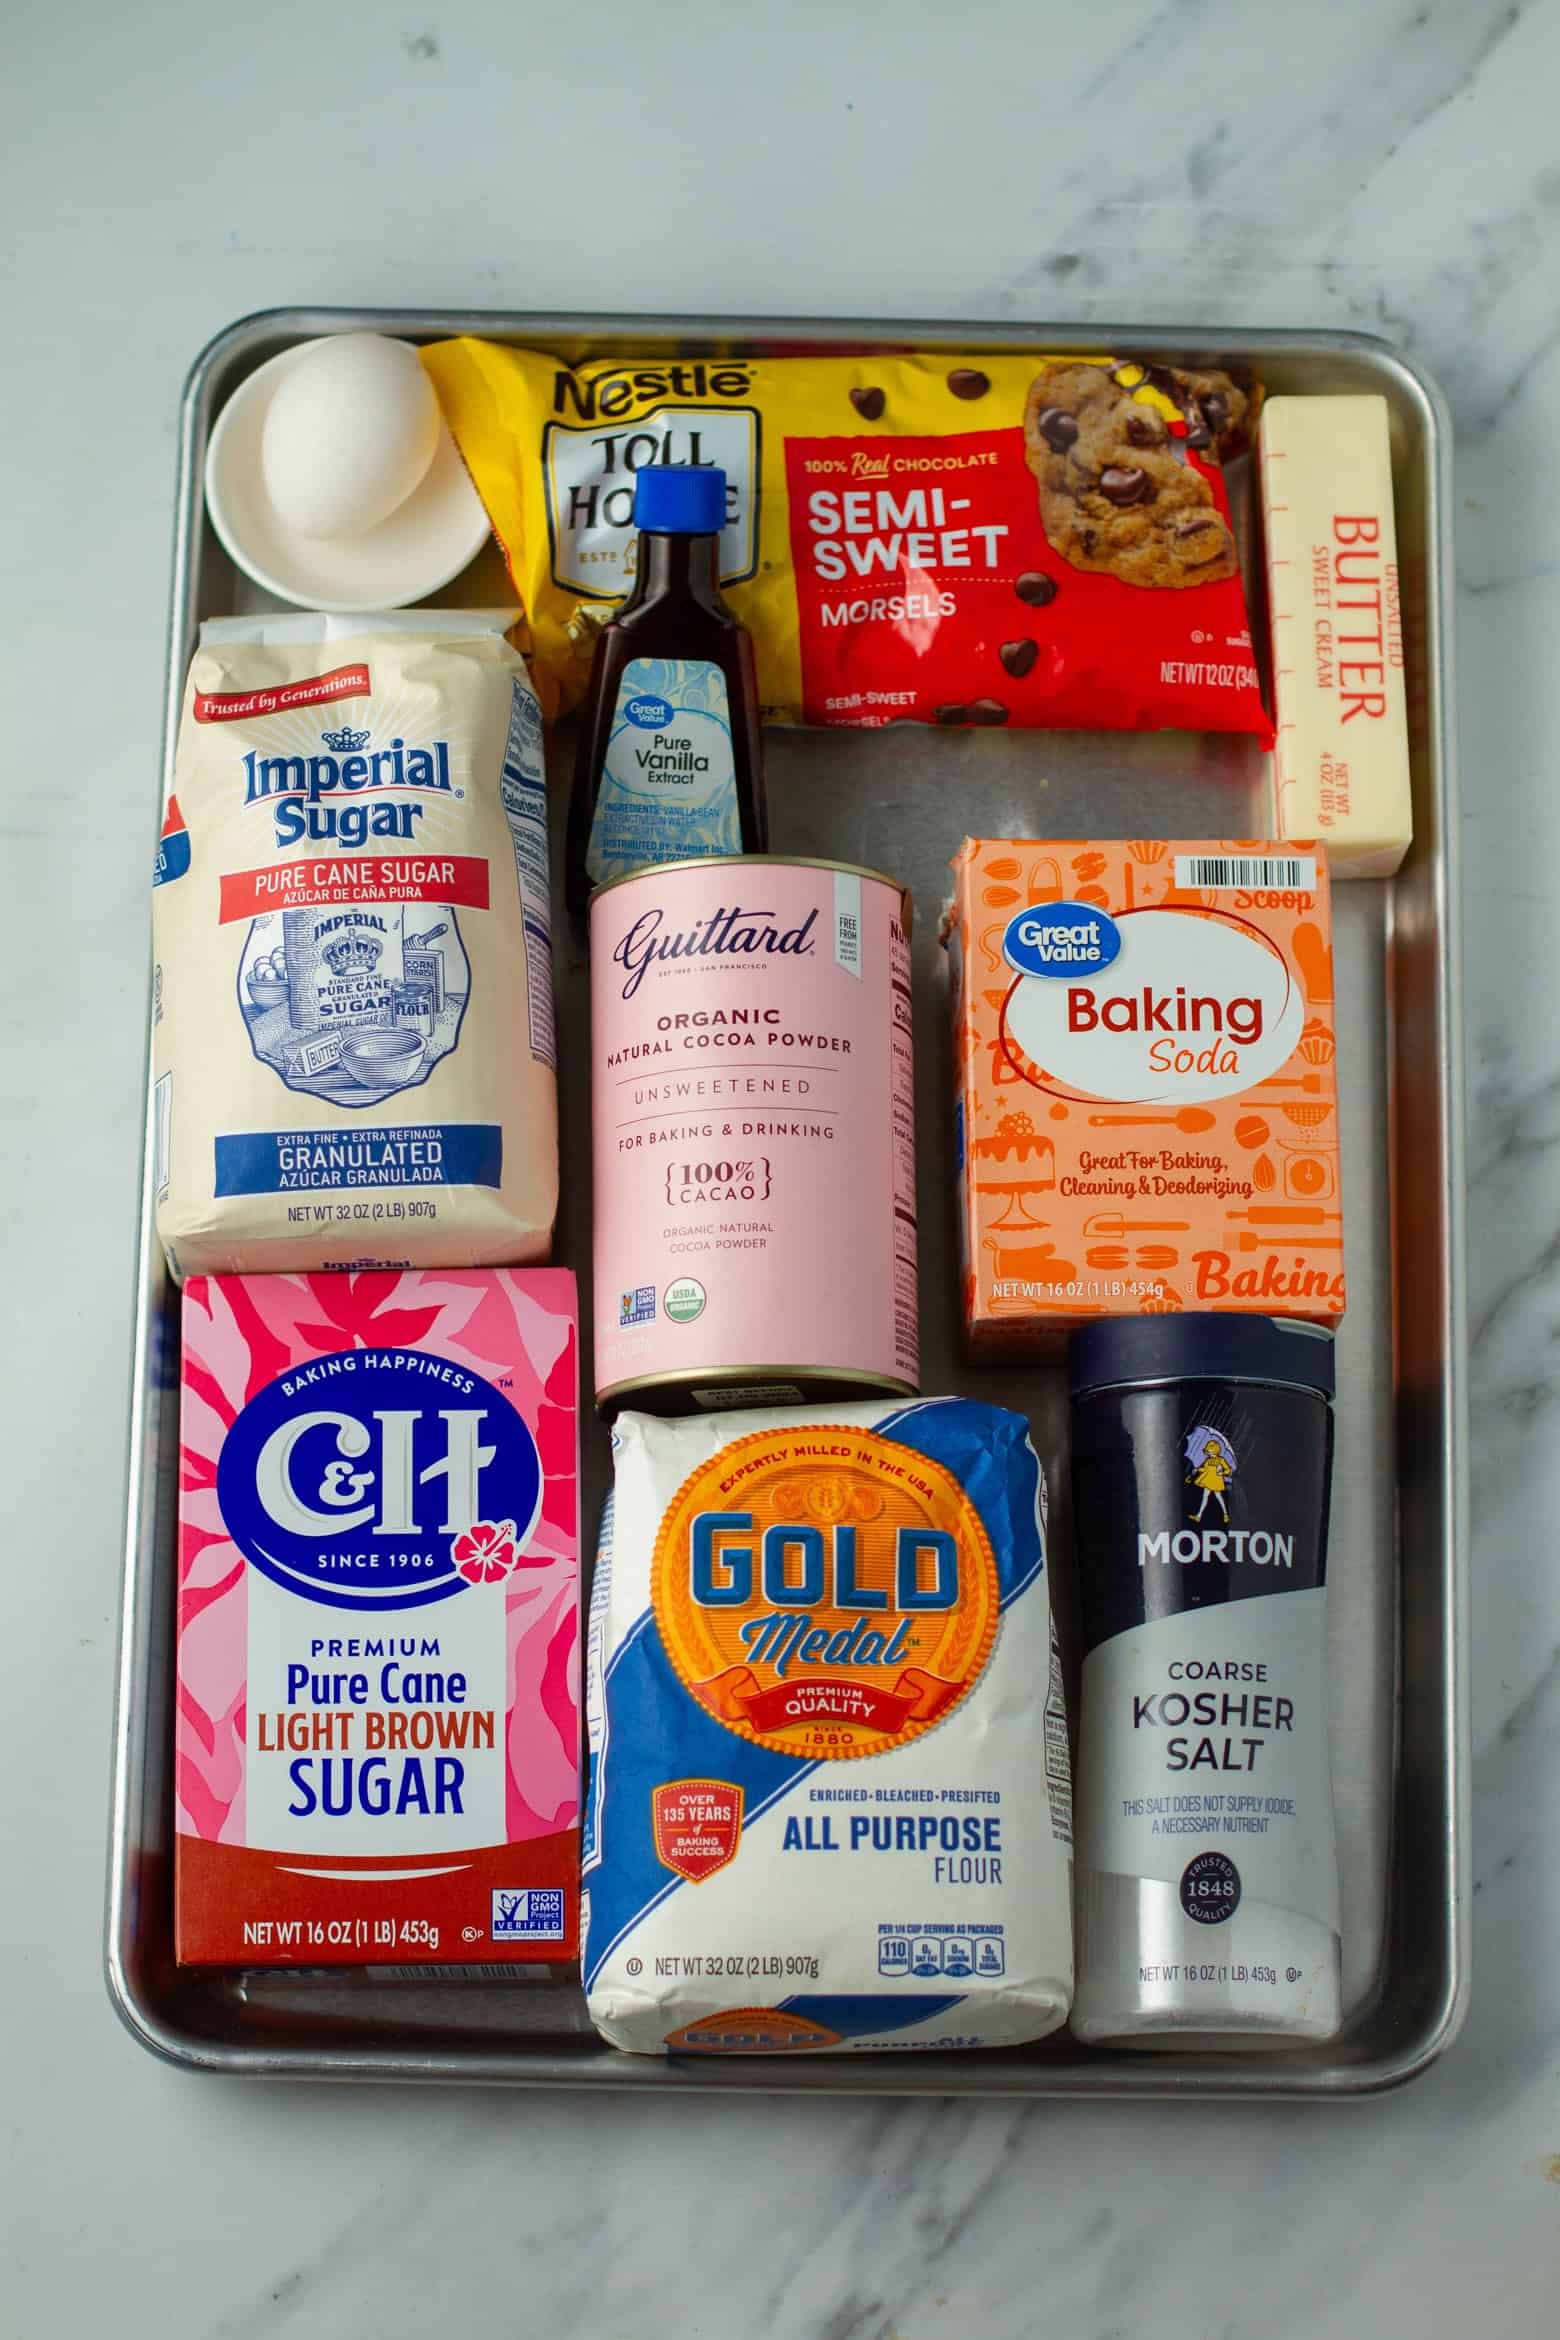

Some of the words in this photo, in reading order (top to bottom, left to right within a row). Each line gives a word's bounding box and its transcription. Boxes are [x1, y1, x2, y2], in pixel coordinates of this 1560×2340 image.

[592, 431, 715, 474] TOLL
[805, 460, 847, 473] 100%
[852, 452, 890, 476] Real
[894, 452, 998, 472] CHOCOLATE
[808, 488, 971, 534] SEMI-
[814, 526, 1008, 581] SWEET
[1312, 544, 1331, 611] SWEET
[821, 592, 957, 627] MORSELS
[1333, 515, 1386, 726] BUTTER
[1314, 619, 1334, 689] CREAM
[203, 700, 255, 715] Trusted
[259, 693, 277, 710] by
[280, 675, 364, 703] Generations
[826, 692, 916, 710] SEMI-SWEET
[630, 702, 665, 715] Great
[638, 714, 664, 723] Value
[654, 735, 692, 751] Pure
[241, 738, 452, 805] Imperial
[636, 750, 709, 771] Vanilla
[648, 771, 694, 784] Extract
[275, 797, 423, 848] Sugar
[255, 866, 305, 896] PURE
[313, 864, 373, 886] CANE
[381, 863, 455, 884] SUGAR
[284, 885, 329, 903] AZÚCAR
[334, 889, 349, 900] DE
[352, 884, 386, 899] CAÑA
[390, 887, 422, 899] PURA
[315, 914, 387, 941] IMPERIAL
[840, 917, 856, 930] FREE
[840, 929, 856, 940] FROM
[1018, 921, 1101, 946] Great
[614, 906, 819, 1000] Guittard
[1039, 945, 1101, 962] Value
[318, 984, 353, 998] PURE
[356, 979, 391, 992] CANE
[320, 996, 392, 1016] SUGAR
[1068, 987, 1262, 1044] Baking
[657, 1009, 781, 1031] ORGANIC
[608, 1039, 672, 1069] NATURAL
[683, 1033, 756, 1049] COCOA
[768, 1033, 851, 1053] POWDER
[1149, 1038, 1240, 1074] Soda
[635, 1079, 810, 1104] UNSWEETENED
[277, 1134, 310, 1146] EXTRA
[314, 1133, 339, 1144] FINE
[352, 1131, 386, 1142] EXTRA
[389, 1130, 442, 1141] REFINADA
[619, 1136, 643, 1152] FOR
[649, 1125, 713, 1144] BAKING
[722, 1124, 731, 1135] &
[742, 1123, 834, 1139] DRINKING
[279, 1142, 442, 1170] GRANULATED
[1080, 1151, 1127, 1174] Great
[1127, 1151, 1158, 1170] For
[1160, 1151, 1228, 1173] Baking,
[280, 1168, 341, 1188] AZÚCAR
[347, 1166, 442, 1184] GRANULADA
[1061, 1176, 1136, 1197] Cleaning
[1139, 1176, 1151, 1195] &
[1154, 1177, 1254, 1199] Deodorizing
[680, 1186, 755, 1203] CACAO
[288, 1207, 311, 1222] NET
[314, 1206, 332, 1220] WT
[336, 1206, 350, 1219] 32
[354, 1205, 370, 1218] OZ
[372, 1204, 383, 1220] (2
[386, 1203, 405, 1218] LB)
[408, 1202, 436, 1218] 907g
[663, 1223, 714, 1239] ORGANIC
[719, 1223, 774, 1233] NATURAL
[670, 1241, 711, 1253] COCOA
[715, 1239, 767, 1250] POWDER
[638, 1288, 654, 1296] NON
[673, 1288, 696, 1299] USDA
[282, 1357, 356, 1397] BAKING
[365, 1355, 475, 1394] HAPPINESS
[256, 1410, 497, 1537] C&H
[720, 1449, 788, 1494] EXPERTLY
[794, 1446, 851, 1459] MILLED
[857, 1450, 873, 1465] IN
[878, 1458, 906, 1478] THE
[907, 1473, 935, 1500] USA
[318, 1554, 380, 1567] SINCE
[389, 1553, 434, 1567] 1906
[1138, 1530, 1293, 1569] MORTON
[690, 1511, 960, 1612] GOLD
[311, 1639, 440, 1657] PREMIUM
[740, 1612, 913, 1677] Medal
[1168, 1662, 1268, 1682] COARSE
[288, 1664, 368, 1705] Pure
[381, 1662, 466, 1703] Cane
[797, 1687, 863, 1699] PREMIUM
[785, 1699, 876, 1717] QUALITY
[1133, 1693, 1294, 1731] KOSHER
[258, 1712, 355, 1750] LIGHT
[366, 1711, 495, 1749] BROWN
[805, 1733, 853, 1745] 1880
[1167, 1738, 1264, 1771] SALT
[288, 1757, 465, 1817] SUGAR
[680, 1795, 714, 1806] OVER
[1122, 1800, 1144, 1817] THIS
[1146, 1799, 1170, 1815] SALT
[1174, 1797, 1201, 1813] DOES
[1203, 1795, 1226, 1812] NOT
[1227, 1796, 1263, 1812] SUPPLY
[664, 1807, 686, 1822] 135
[689, 1806, 731, 1821] YEARS
[1152, 1819, 1161, 1834] A
[1162, 1817, 1220, 1834] NECESSARY
[1223, 1816, 1269, 1833] NUTRIENT
[677, 1837, 719, 1847] BAKING
[782, 1816, 839, 1852] ALL
[851, 1816, 1001, 1852] PURPOSE
[670, 1846, 724, 1857] SUCCESS
[935, 1857, 1002, 1884] FLOUR
[1189, 1857, 1234, 1878] TRUSTED
[531, 1893, 559, 1902] NON
[1187, 1880, 1235, 1897] 1848
[531, 1902, 559, 1911] GMO
[1187, 1903, 1232, 1920] QUALITY
[243, 1922, 274, 1944] NET
[276, 1922, 301, 1943] WT
[306, 1922, 323, 1943] 16
[328, 1922, 351, 1943] OZ
[355, 1922, 369, 1947] (1
[374, 1921, 396, 1945] LB)
[400, 1921, 439, 1948] 453g
[879, 1924, 893, 1933] PER
[907, 1925, 922, 1933] CUP
[924, 1925, 955, 1933] SERVING
[957, 1925, 965, 1933] AS
[968, 1924, 1003, 1934] PACKAGED
[884, 1942, 906, 1957] 110
